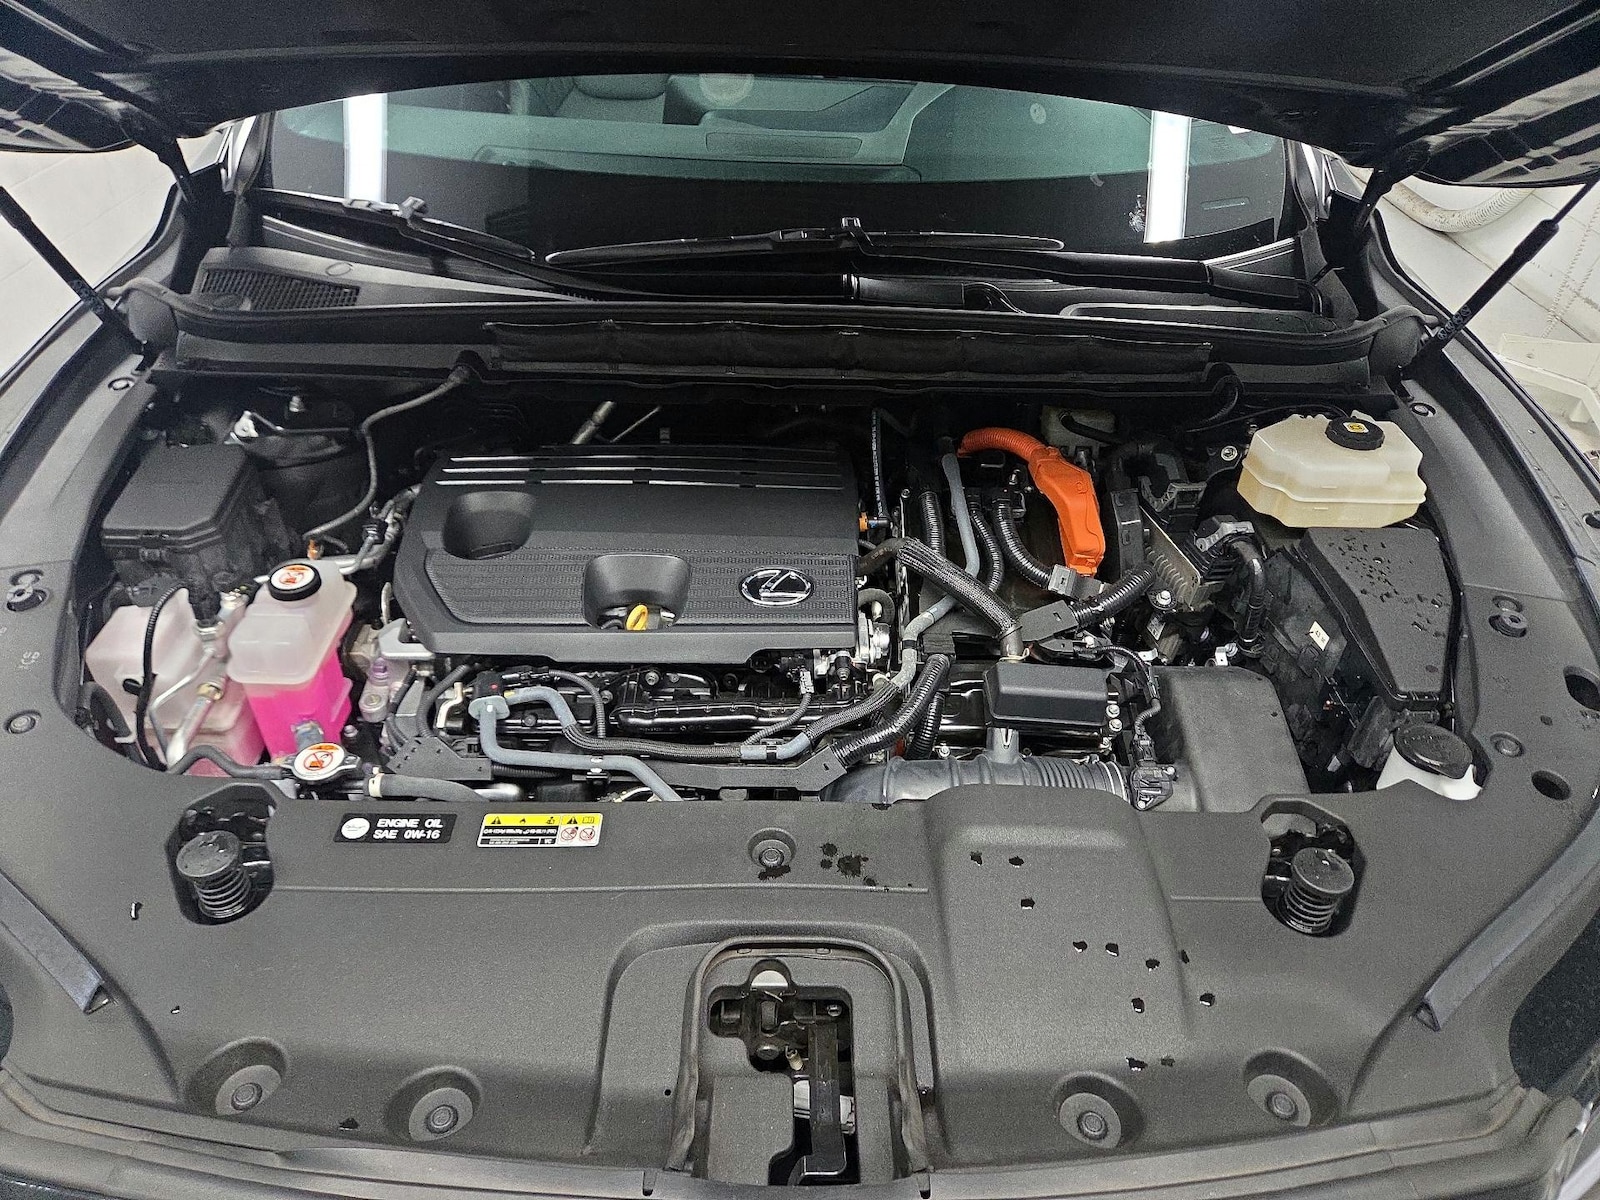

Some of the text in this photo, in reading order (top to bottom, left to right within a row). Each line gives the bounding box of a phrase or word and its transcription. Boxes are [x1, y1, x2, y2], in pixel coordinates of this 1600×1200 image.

[376, 818, 444, 828] ENGINE OIL
[373, 829, 441, 839] SAE 0W-16
